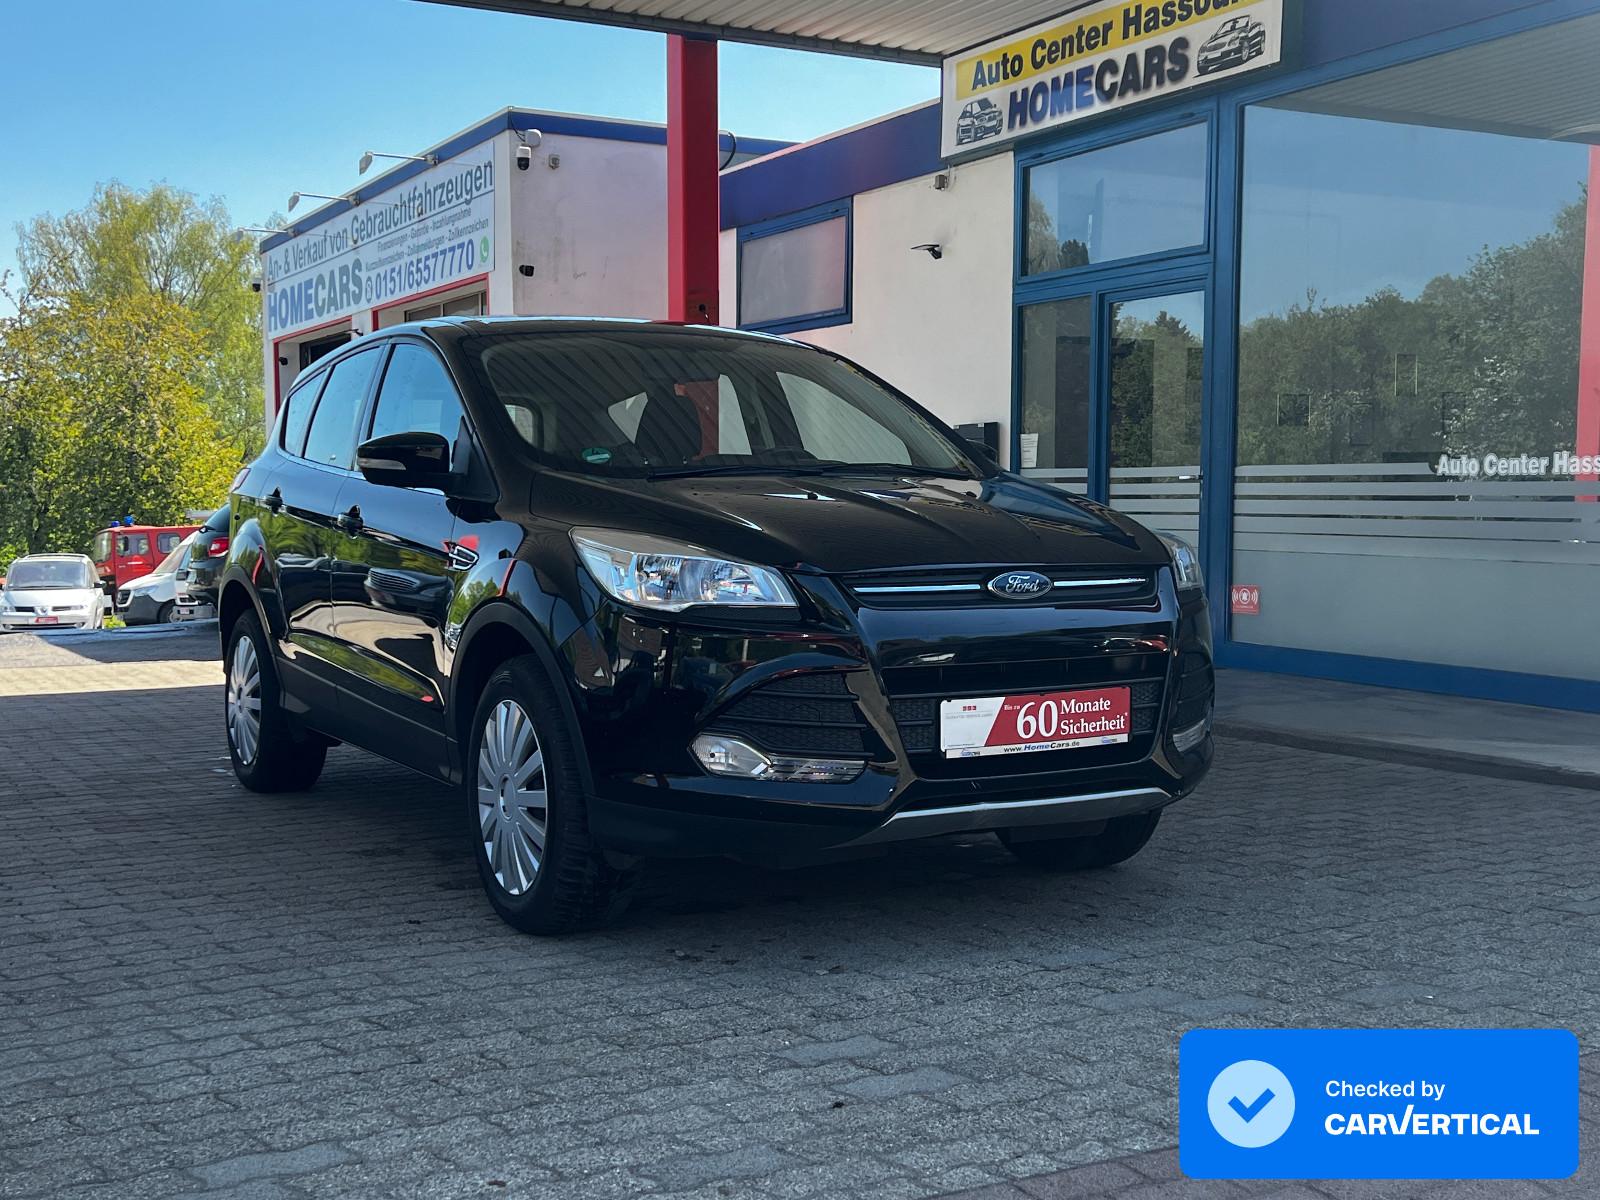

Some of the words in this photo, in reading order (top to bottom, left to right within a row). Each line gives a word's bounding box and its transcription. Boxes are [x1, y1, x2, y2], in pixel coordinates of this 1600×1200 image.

[972, 52, 1024, 91] Auto
[1031, 20, 1113, 70] Center
[1122, 0, 1239, 40] Hasso
[1007, 37, 1190, 131] HOMECARS
[284, 248, 290, 274] &
[292, 227, 328, 270] Verkauf
[329, 231, 348, 255] von
[351, 160, 493, 245] Gebrauchtfahrzeugen
[267, 257, 362, 331] HOMECARS
[376, 238, 475, 300] 0151/65577770
[1437, 453, 1480, 476] Auto
[1484, 452, 1549, 476] Center
[1005, 575, 1039, 593] Ford
[1016, 700, 1059, 738] 60
[1060, 697, 1111, 715] Monate
[1060, 714, 1125, 736] Sicherheit
